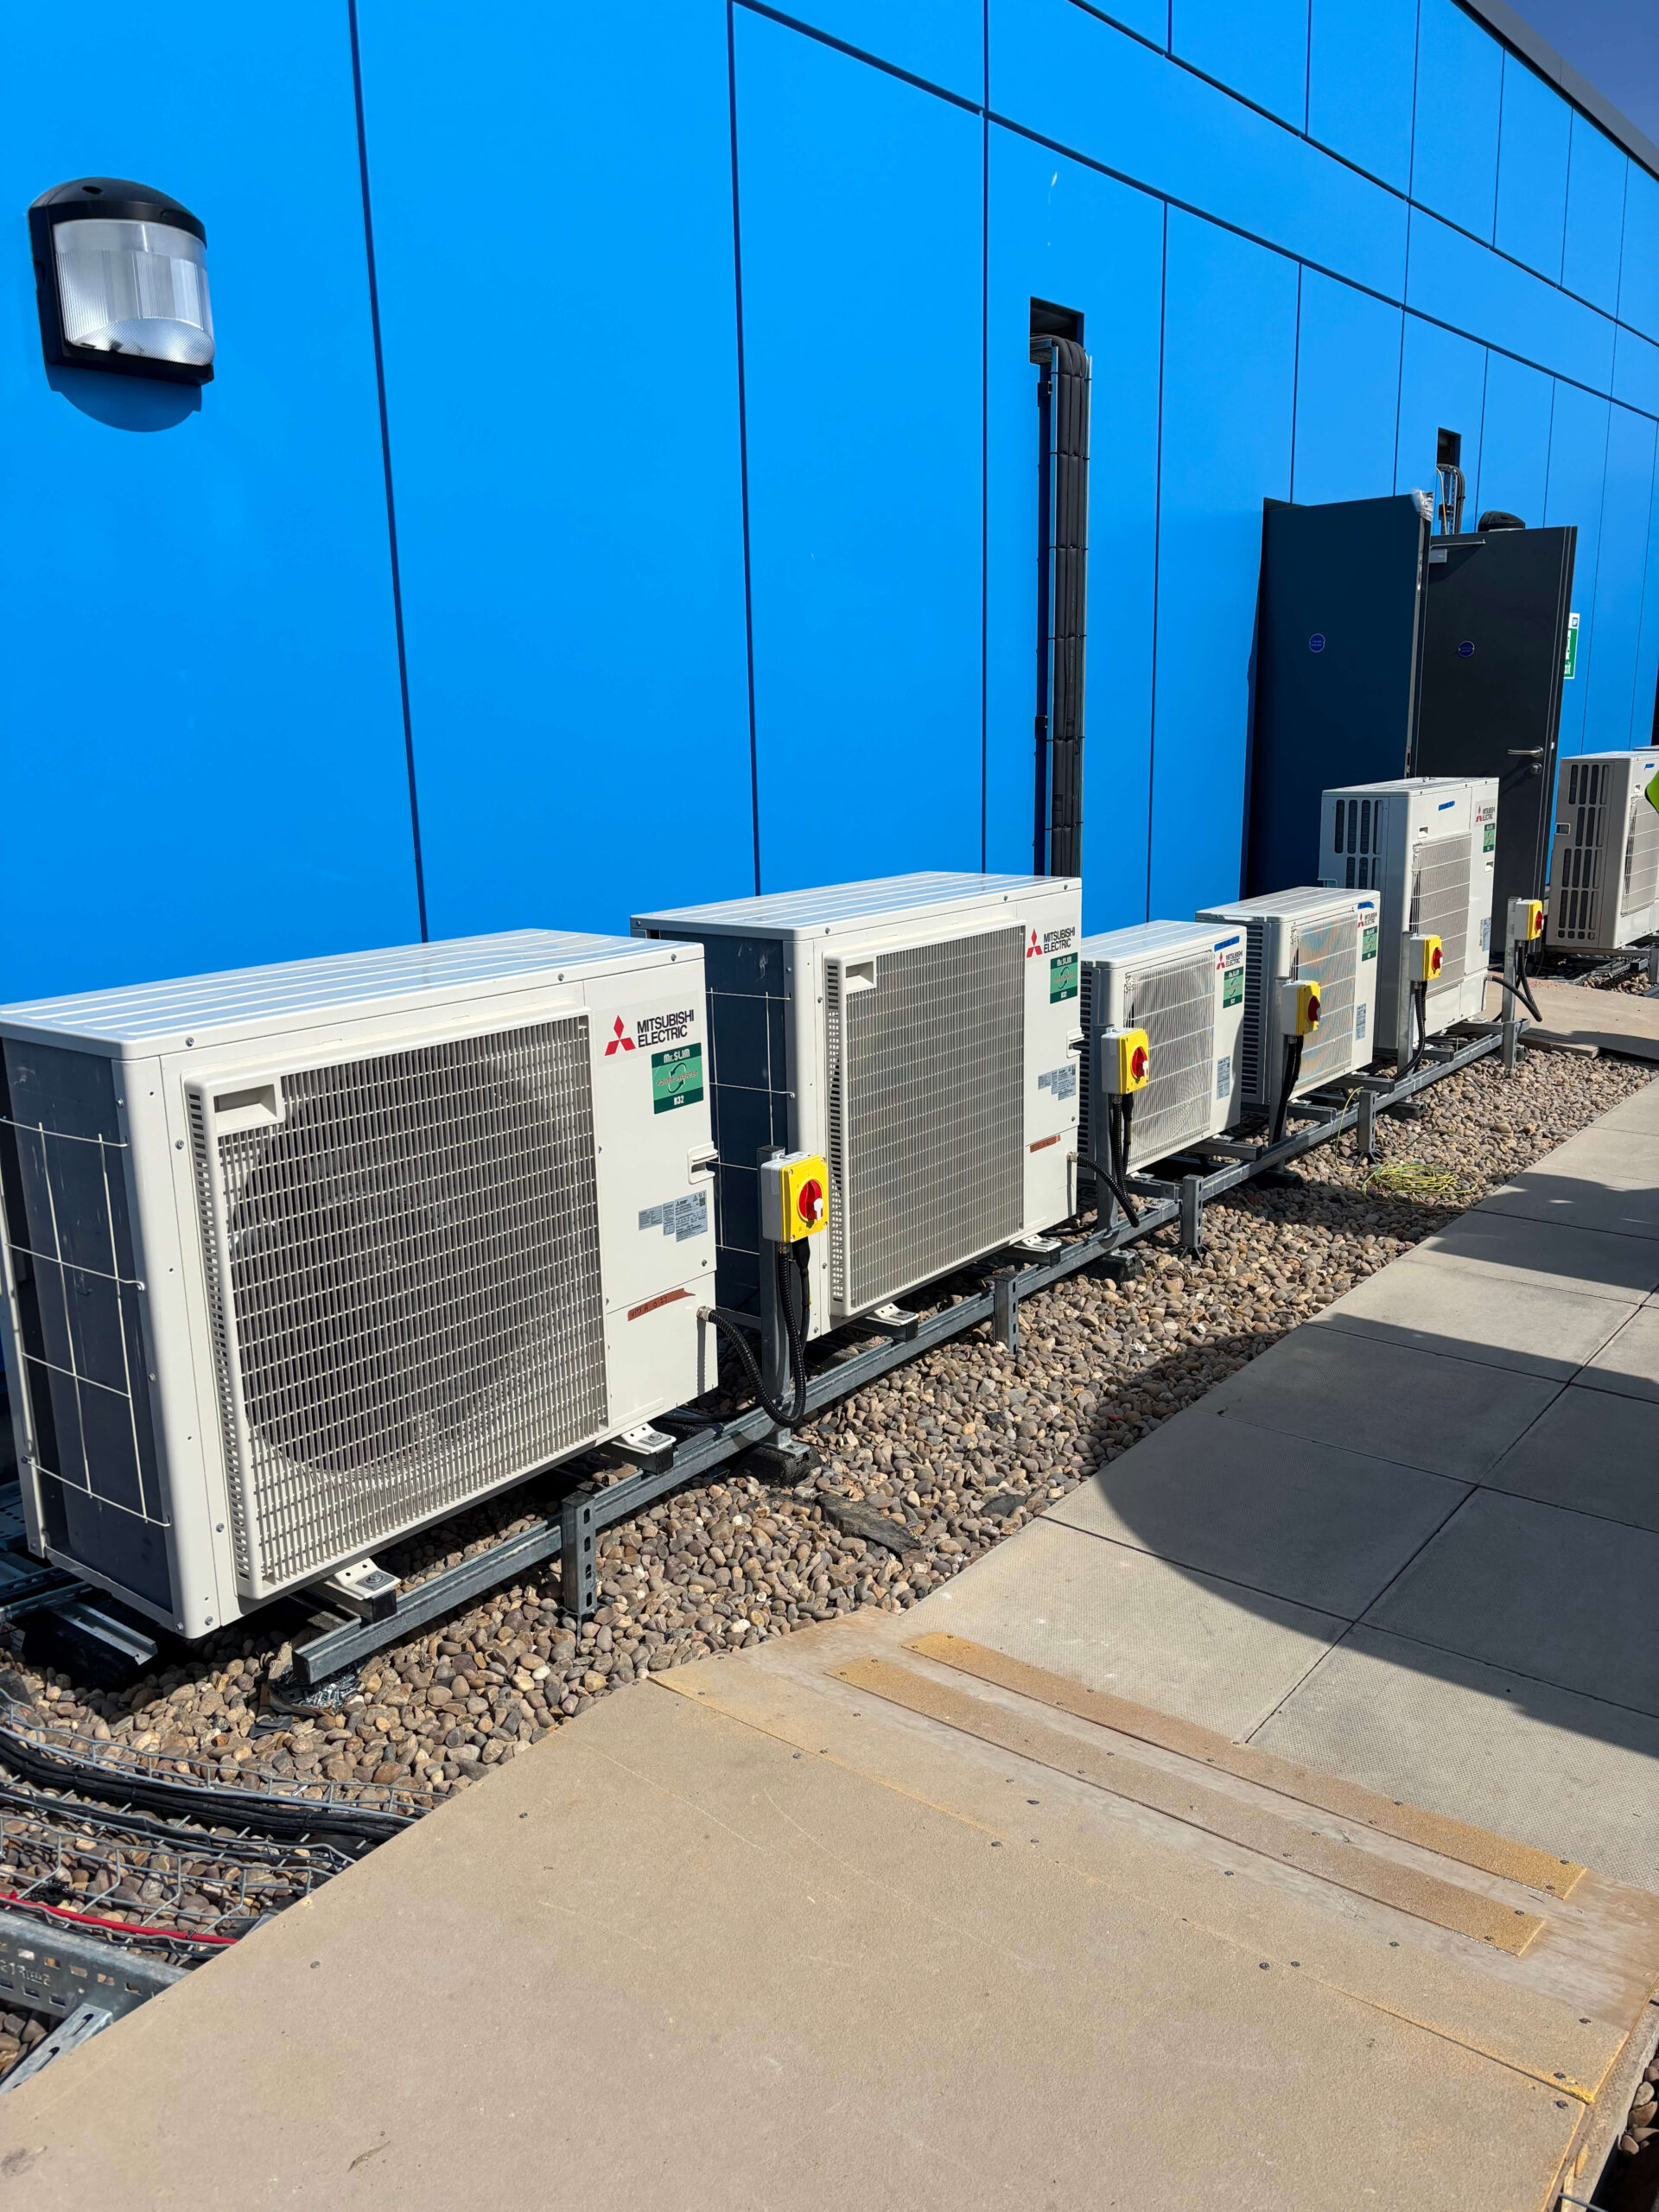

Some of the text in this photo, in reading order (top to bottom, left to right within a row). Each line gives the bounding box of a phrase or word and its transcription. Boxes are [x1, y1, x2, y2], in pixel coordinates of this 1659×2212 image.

[1044, 926, 1076, 944] MITSUBISHI
[1044, 938, 1071, 954] ELECTRIC
[637, 1009, 694, 1033] MITSUBISHI
[638, 1024, 688, 1048] ELECTRIC
[676, 1071, 697, 1081] INVERTER
